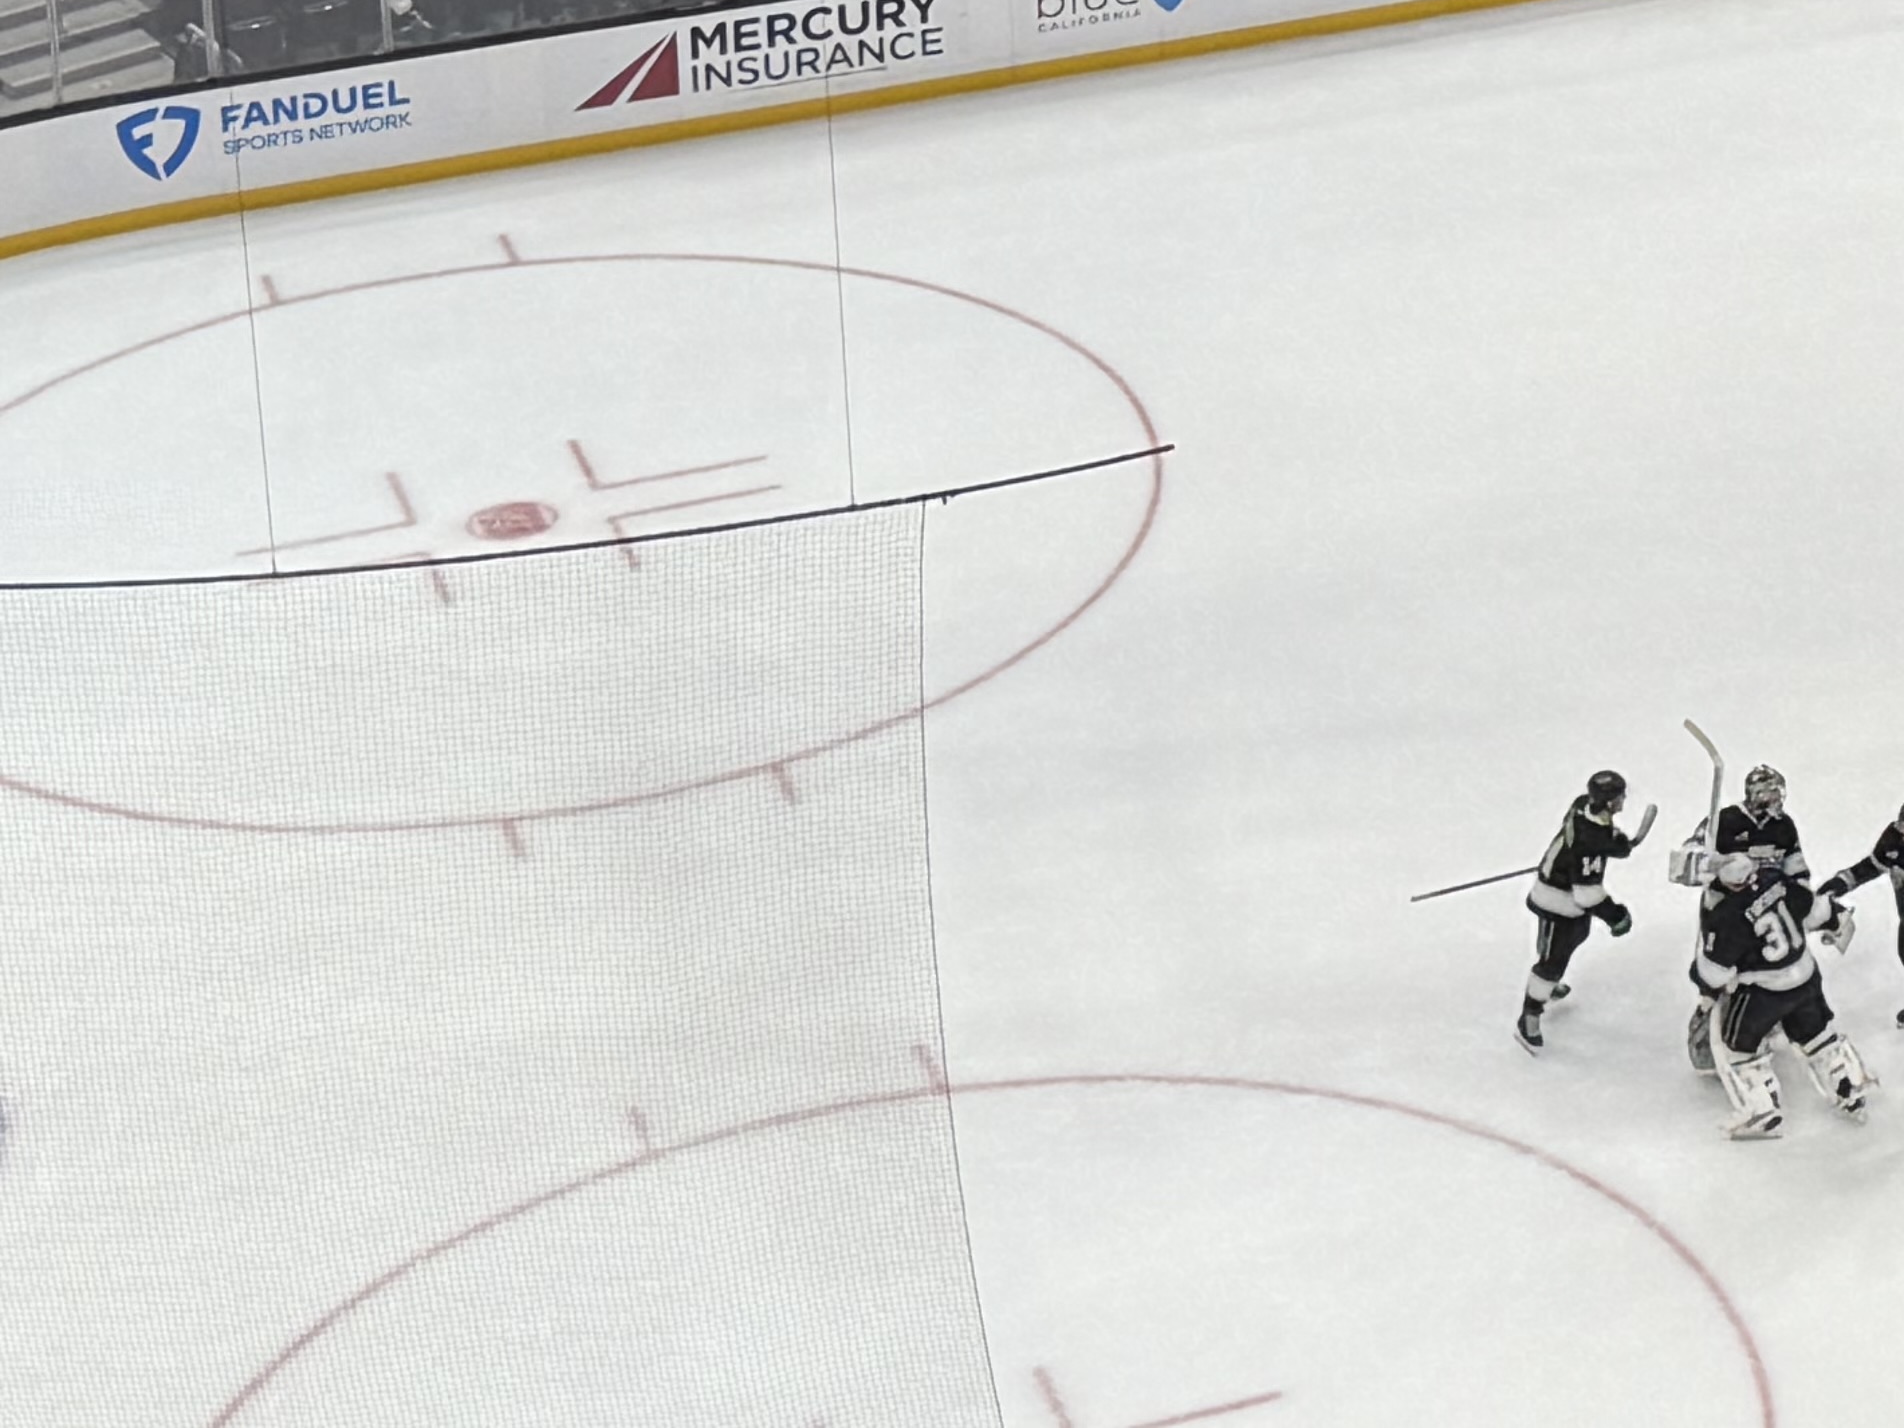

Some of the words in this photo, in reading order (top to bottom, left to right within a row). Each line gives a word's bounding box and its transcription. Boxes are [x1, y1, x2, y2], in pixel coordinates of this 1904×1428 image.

[691, 26, 945, 93] INSURANCE
[221, 79, 411, 134] FANDUEL
[223, 128, 304, 156] SPORTS
[309, 111, 413, 144] NETWORK
[1752, 898, 1802, 963] 31
